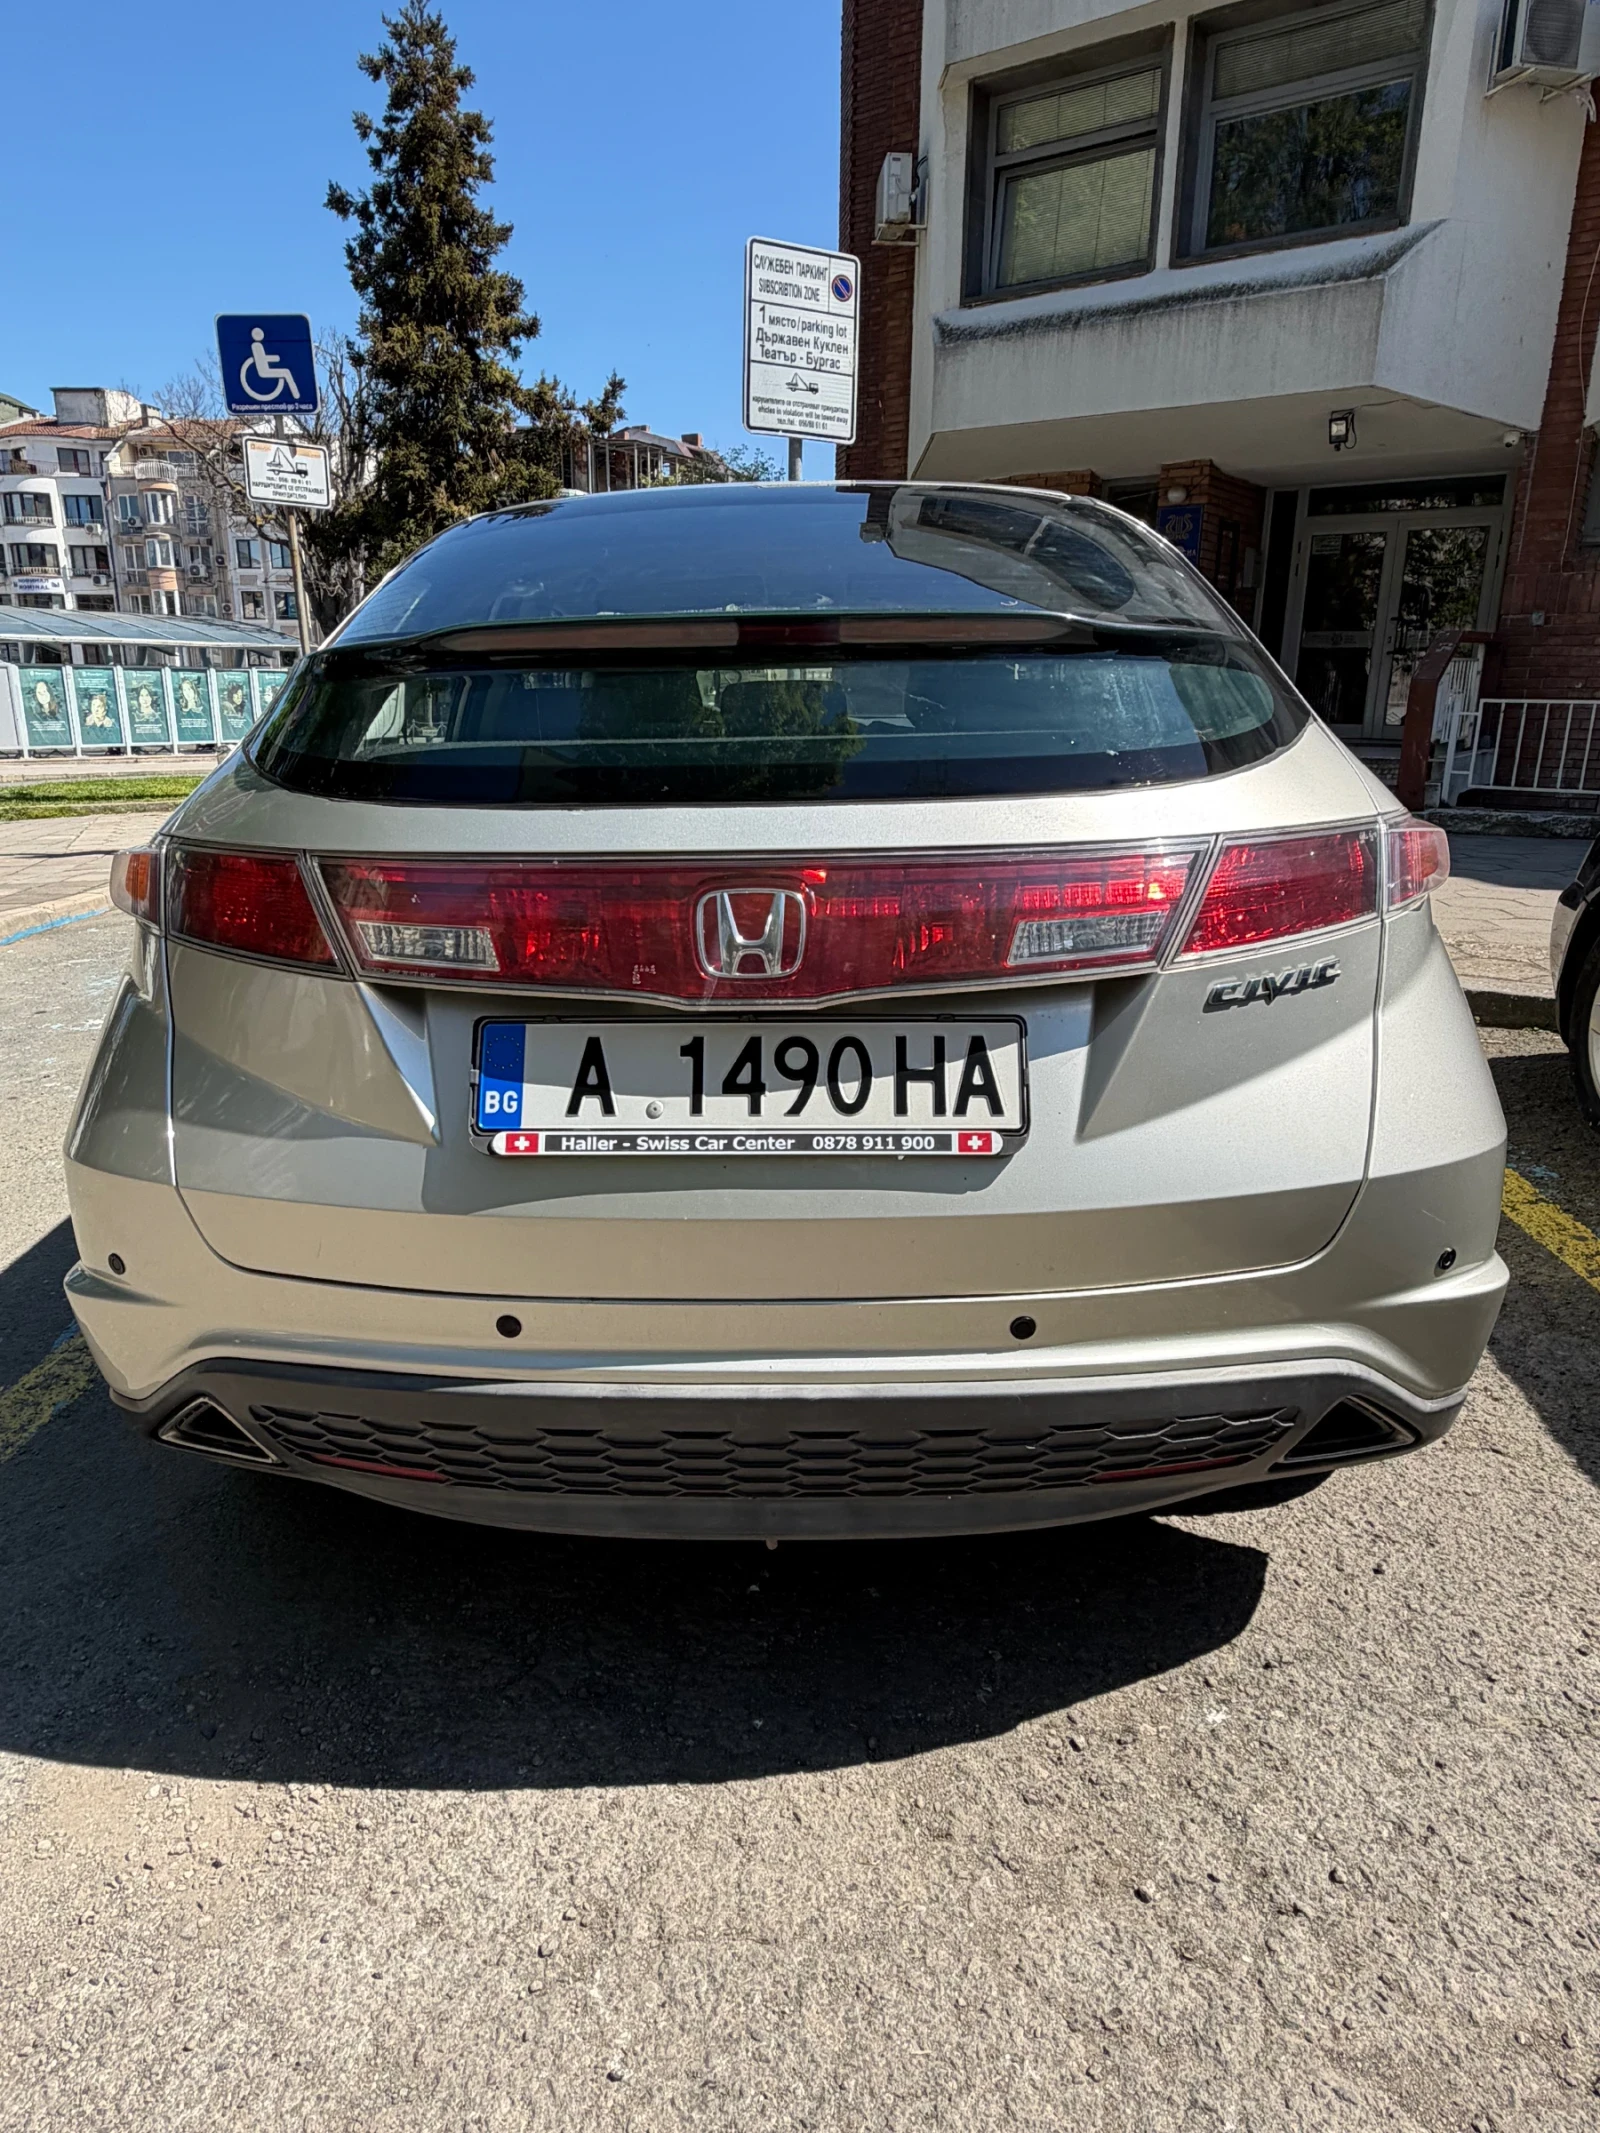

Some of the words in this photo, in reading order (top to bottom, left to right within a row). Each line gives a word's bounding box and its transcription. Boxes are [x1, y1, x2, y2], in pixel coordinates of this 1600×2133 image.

[754, 254, 794, 275] СЛУЖЕБЕН
[796, 262, 828, 281] ПАРКИНГ
[804, 286, 820, 302] ZONE
[759, 304, 766, 324] 1
[836, 324, 848, 338] lot
[756, 327, 810, 349] Държавен
[814, 336, 849, 355] Куклен
[760, 344, 797, 364] Театър
[806, 352, 841, 370] Бургас
[1206, 957, 1342, 1006] CIVIC
[565, 1036, 617, 1118] A
[679, 1035, 873, 1118] 1490
[894, 1035, 1005, 1118] HA
[484, 1090, 519, 1114] BG
[561, 1136, 617, 1150] Haller
[636, 1136, 690, 1150] Swiss
[693, 1136, 728, 1150] Car
[732, 1136, 795, 1150] Center
[812, 1136, 858, 1150] 0878
[862, 1136, 896, 1150] 911
[901, 1136, 935, 1150] 900
